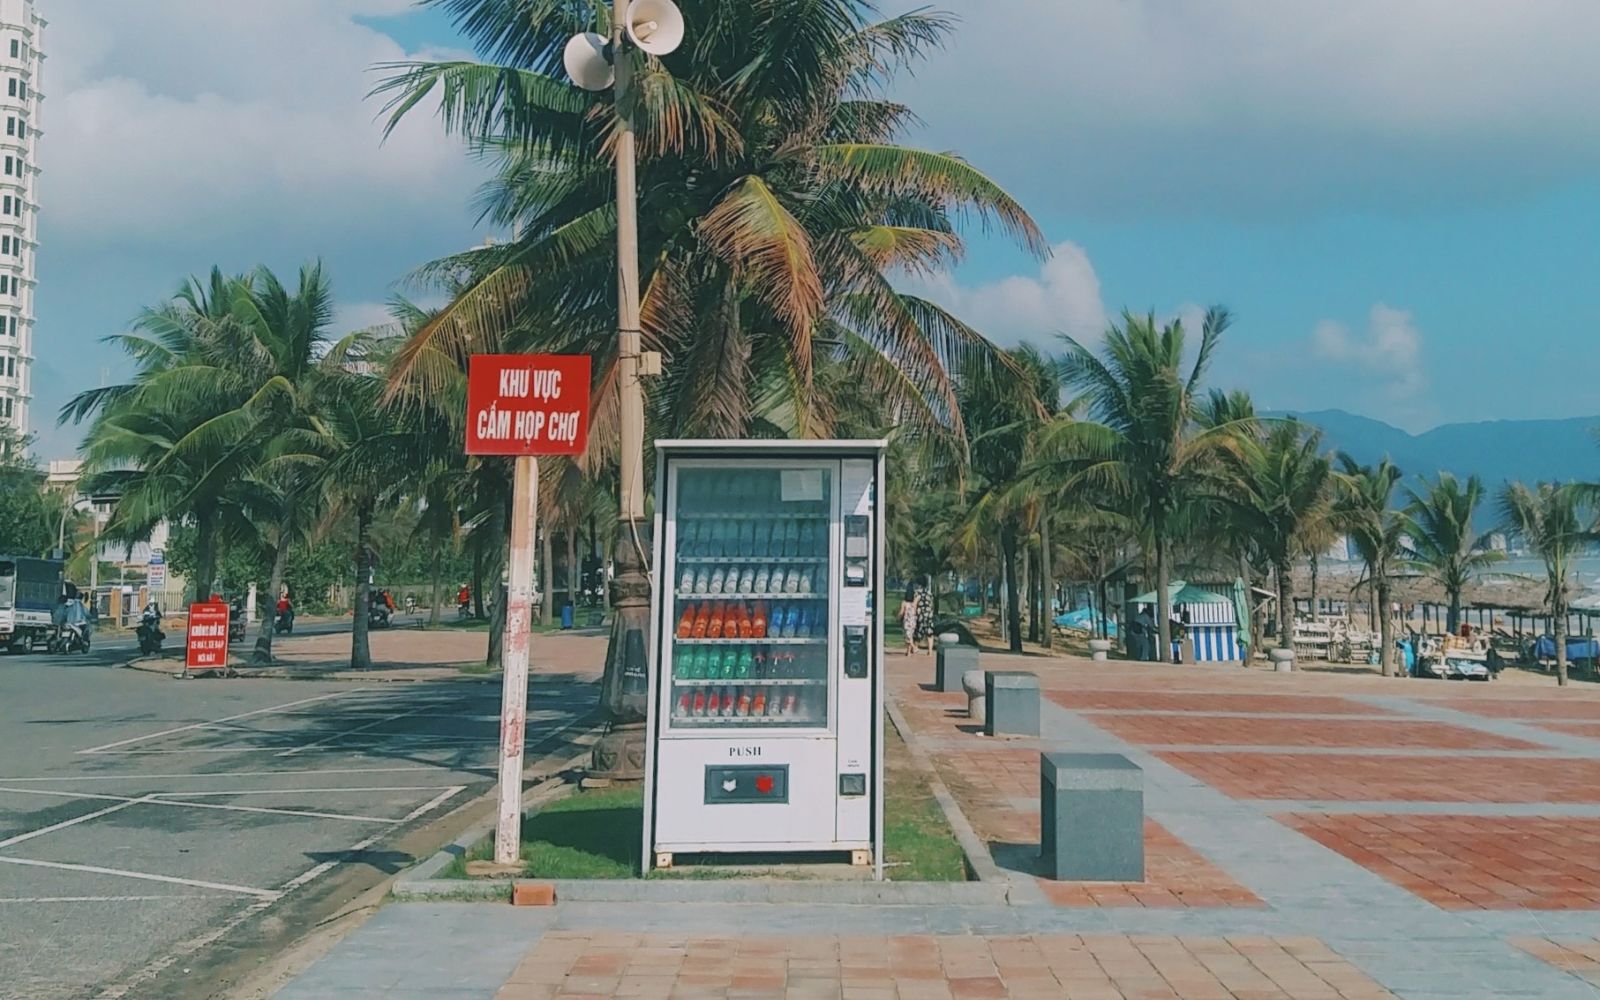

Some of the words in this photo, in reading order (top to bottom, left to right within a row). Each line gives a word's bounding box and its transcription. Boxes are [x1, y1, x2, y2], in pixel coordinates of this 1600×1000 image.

[499, 368, 530, 397] KHU
[534, 368, 562, 403] VỰC
[476, 400, 511, 440] CẤM
[514, 410, 545, 444] HỌP
[548, 410, 580, 447] CHỢ
[729, 746, 761, 757] PUSH
